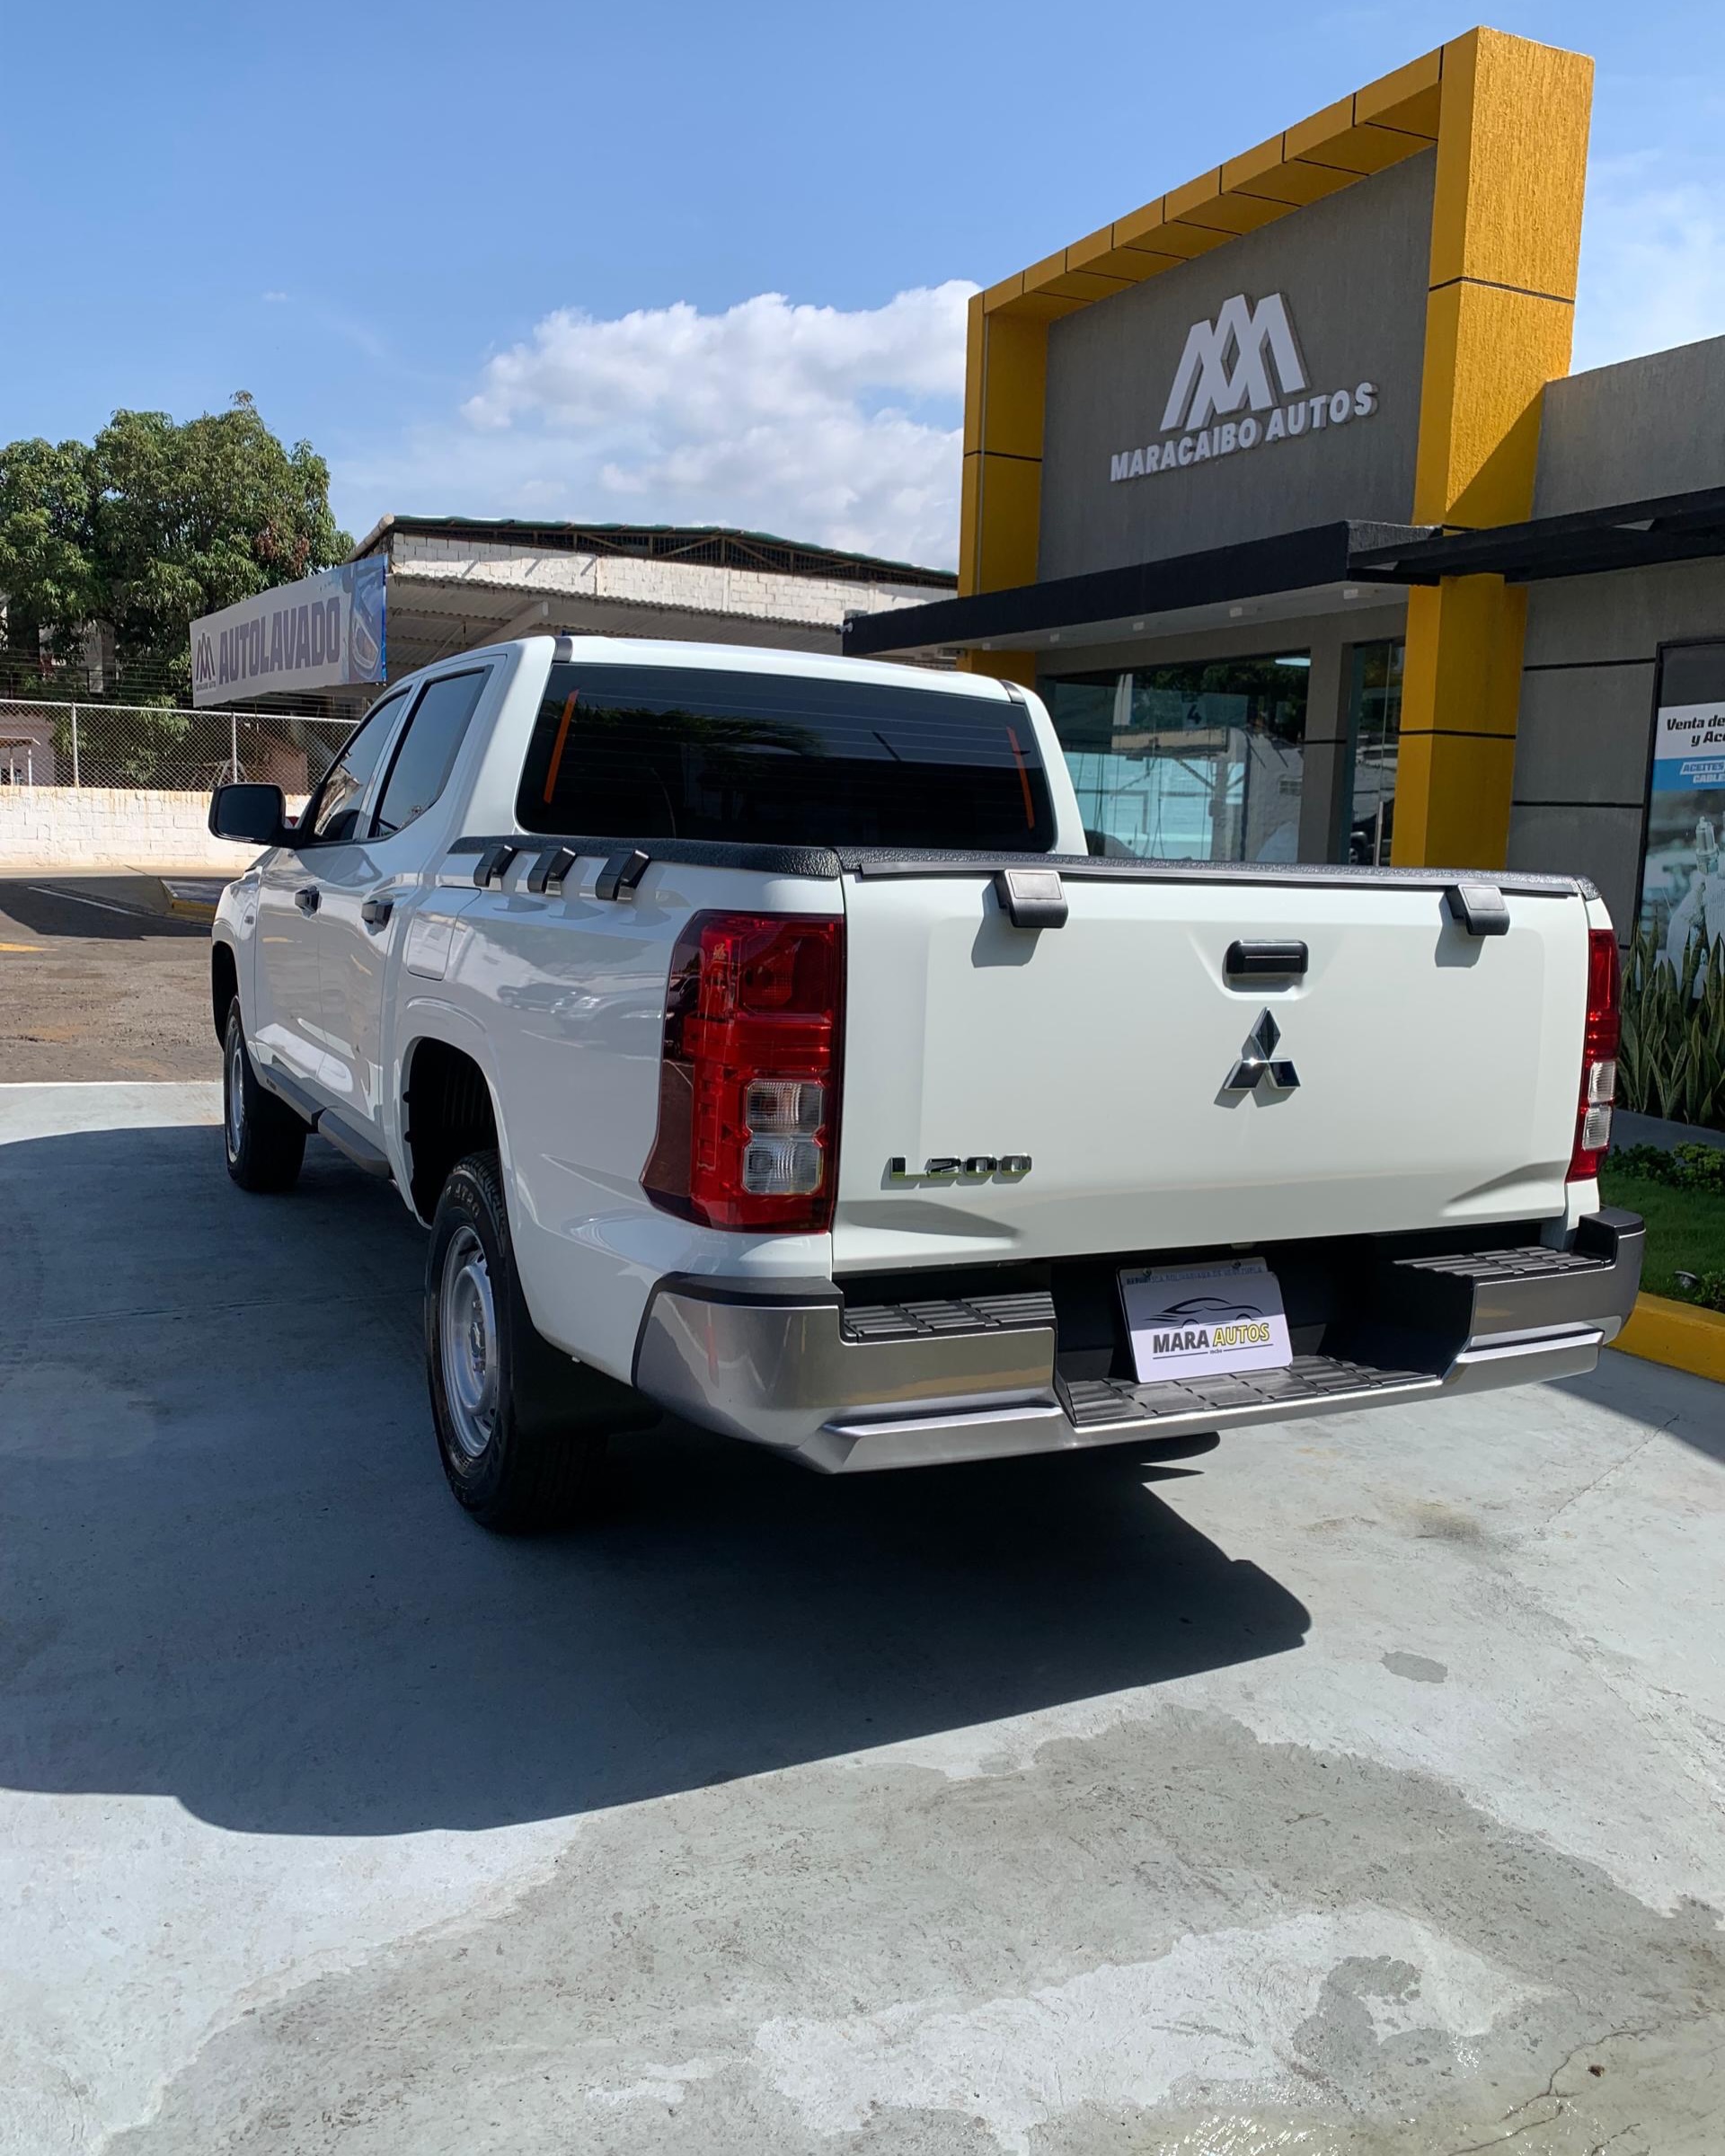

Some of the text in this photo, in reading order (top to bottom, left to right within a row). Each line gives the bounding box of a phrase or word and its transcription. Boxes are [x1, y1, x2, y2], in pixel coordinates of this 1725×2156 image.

[1110, 382, 1378, 482] MARACAIBO AUTOS
[219, 596, 341, 685] AUTOLAVADO
[1667, 715, 1725, 730] Venta de
[1691, 735, 1701, 747] y
[890, 1154, 1033, 1180] L200
[1153, 1322, 1269, 1354] MARA AUTOS
